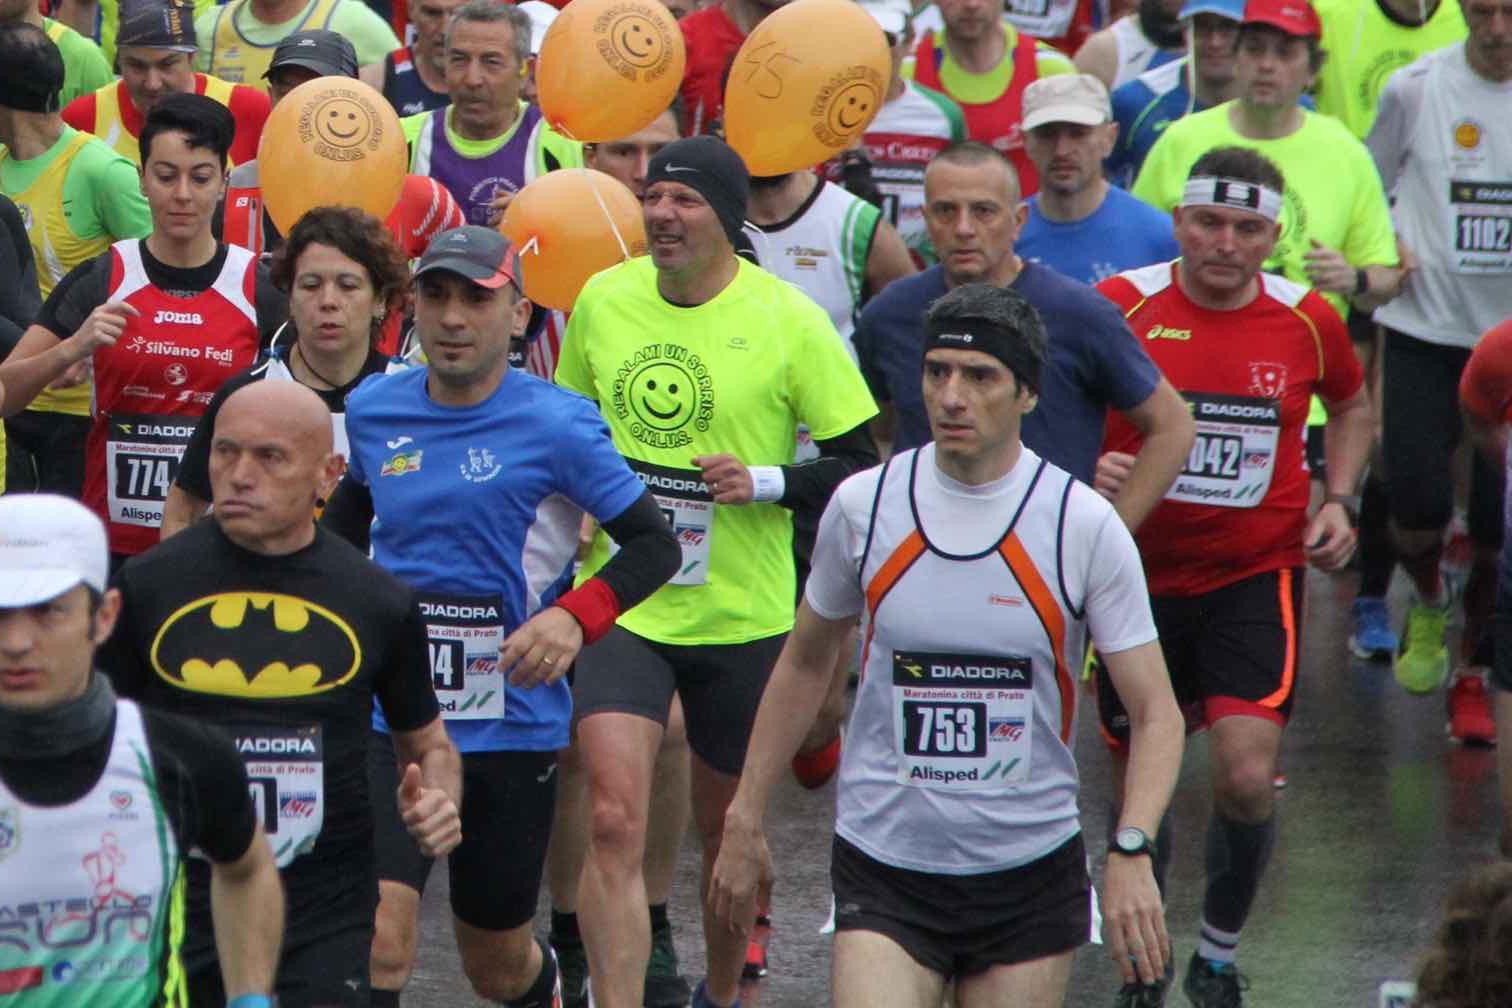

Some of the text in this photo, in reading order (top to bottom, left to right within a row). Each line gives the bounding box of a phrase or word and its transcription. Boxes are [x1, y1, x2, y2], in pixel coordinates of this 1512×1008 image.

[145, 340, 234, 363] Silvano Fedi
[613, 343, 715, 434] REGALAMI UN SORRISO
[1200, 402, 1278, 420] DIADORA
[1188, 436, 1241, 477] 042
[127, 459, 170, 497] 774
[121, 506, 162, 523] Alispe
[931, 665, 1026, 680] DIADORA
[903, 689, 957, 700] Maratonina
[917, 706, 976, 753] 753
[910, 765, 979, 783] Alisped
